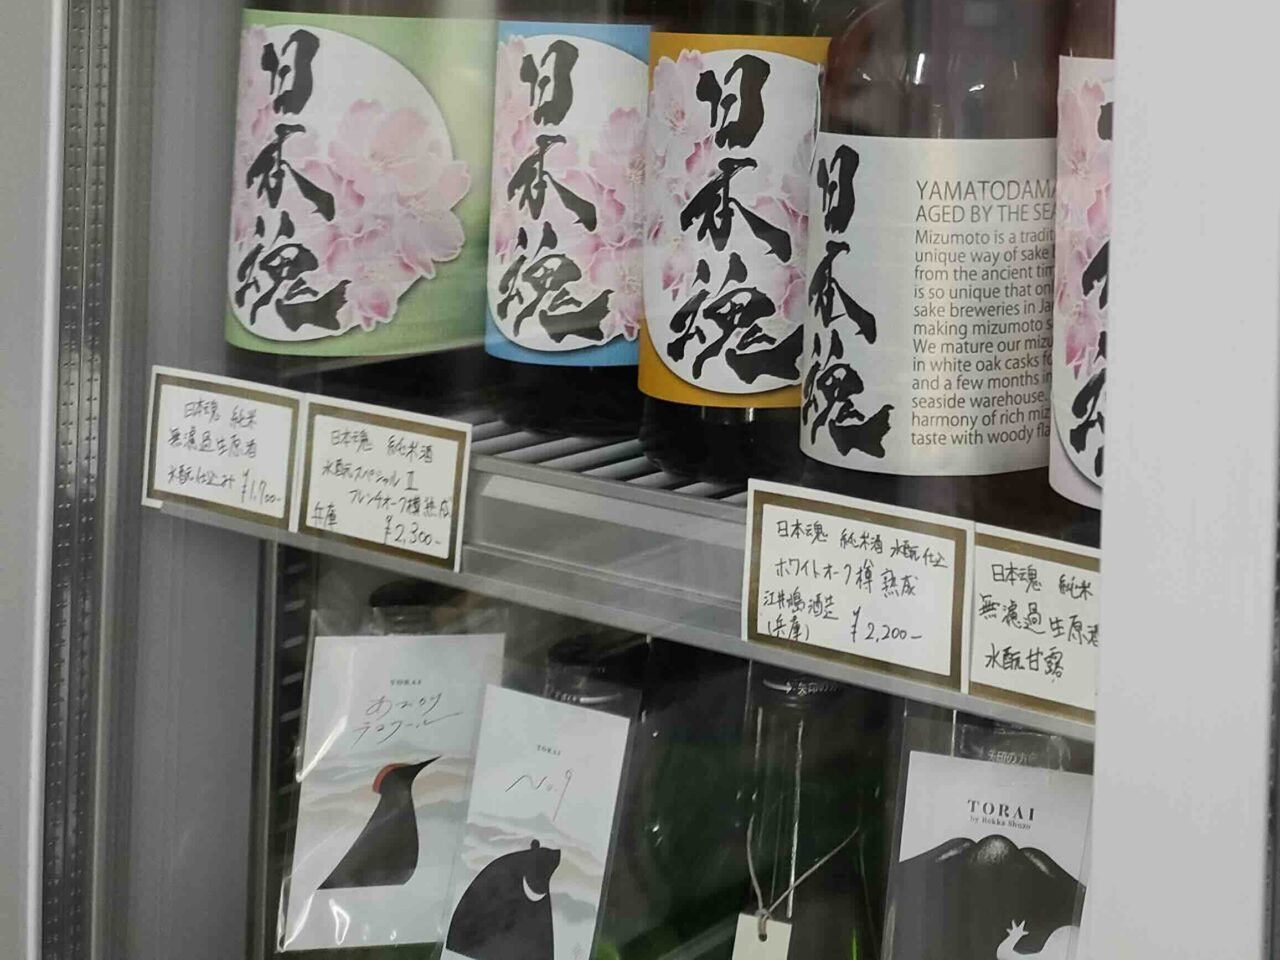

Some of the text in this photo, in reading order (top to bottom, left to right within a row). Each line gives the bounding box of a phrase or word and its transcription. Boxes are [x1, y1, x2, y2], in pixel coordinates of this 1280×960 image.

[234, 28, 352, 332] 日本魂
[499, 39, 614, 343] 日本魂
[667, 53, 803, 385] 日本魂
[916, 204, 965, 222] AGED
[970, 204, 993, 222] BY
[997, 204, 1028, 222] THE
[915, 229, 990, 245] Mizumoto
[994, 230, 1004, 245] is
[1008, 232, 1017, 244] a
[915, 244, 1049, 267] unique way of sake
[914, 265, 1033, 281] from the ancient
[801, 144, 895, 458] 日本魂
[914, 282, 1032, 303] is so unique that
[913, 300, 1036, 318] sake breweries in
[913, 319, 1043, 340] making mizumoto
[913, 339, 937, 354] We
[940, 341, 994, 354] mature
[997, 340, 1021, 353] our
[913, 352, 1040, 372] in white oak casks
[912, 375, 940, 391] and
[943, 379, 952, 390] a
[956, 374, 984, 390] few
[987, 370, 1039, 390] months
[911, 390, 1049, 409] seaside warehouse.
[911, 411, 979, 431] harmony
[982, 409, 997, 427] of
[1000, 408, 1025, 425] rich
[911, 433, 948, 446] taste
[951, 429, 984, 446] with
[987, 424, 1035, 445] woody
[776, 518, 828, 546] 日本魂
[839, 527, 883, 555] 純米酒
[991, 561, 1095, 602] 日本魂 純米
[967, 799, 1036, 822] TORAI
